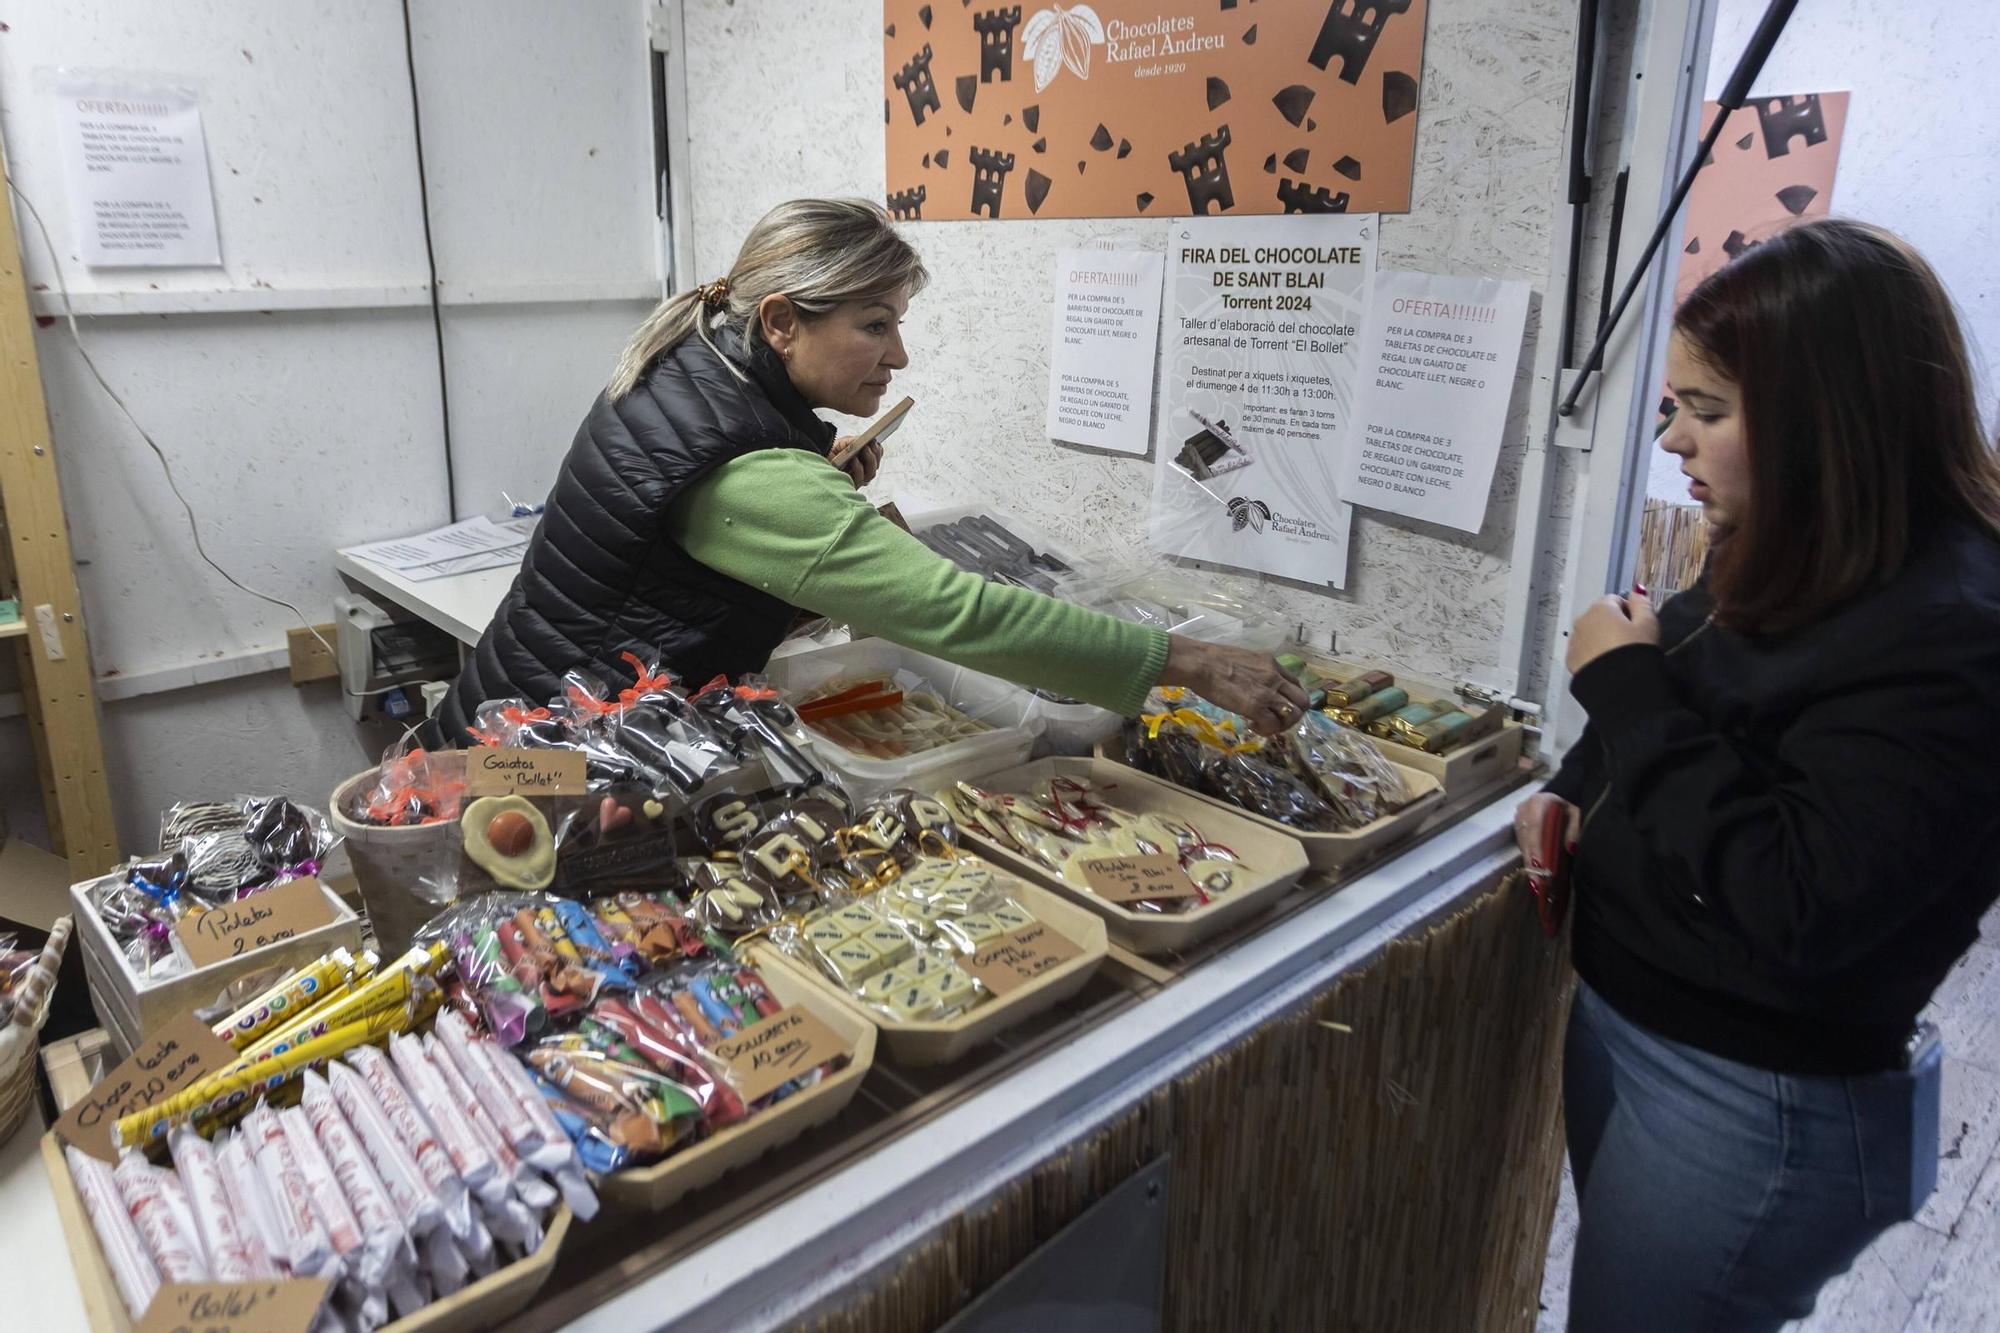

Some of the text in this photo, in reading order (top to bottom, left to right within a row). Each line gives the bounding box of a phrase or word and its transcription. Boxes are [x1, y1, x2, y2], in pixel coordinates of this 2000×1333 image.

[1107, 16, 1194, 42] Chocolates
[1106, 33, 1225, 63] Rafael Andreu
[1135, 63, 1186, 78] desde 1920
[1182, 247, 1361, 264] FIRA DEL CHOCOLATE
[1213, 272, 1324, 288] DE SANT BLAI
[1102, 307, 1134, 316] CHOCOLATE
[1222, 294, 1312, 311] Torrent 2024
[1392, 299, 1496, 323] OFERTA!!!!!!!
[1180, 318, 1207, 329] Taller
[1279, 322, 1295, 333] del
[1299, 322, 1355, 336] chocolate
[1387, 326, 1472, 344] PER LA COMPRA DE 3
[1184, 335, 1230, 347] artesanal
[1234, 336, 1247, 349] de
[1251, 338, 1288, 350] Torrent
[1385, 339, 1497, 361] TABLETAS DE CHOCOLATE DE
[1381, 352, 1467, 372] REGAL UN GAIATO DE
[1192, 366, 1226, 377] Destinat
[1228, 370, 1242, 380] per
[1244, 371, 1250, 379] a
[1252, 371, 1284, 383] xiquets
[1291, 374, 1332, 386] xiquetes,
[1379, 365, 1485, 389] CHOCOLATE LLET, NEGRE O
[1186, 380, 1194, 388] el
[1196, 380, 1237, 393] diumenge
[1240, 383, 1245, 392] 4
[1248, 383, 1258, 393] de
[1262, 385, 1290, 396] 11:30h
[1294, 389, 1299, 397] a
[1243, 414, 1251, 422] de
[1253, 415, 1262, 423] 30
[1290, 419, 1300, 427] En
[1302, 420, 1319, 429] cada
[1321, 422, 1335, 430] torn
[1289, 407, 1308, 416] faran
[1310, 409, 1315, 417] 3
[1317, 410, 1335, 419] torns
[1059, 417, 1075, 425] NEGRO
[1083, 420, 1105, 429] BLANCO
[1265, 426, 1274, 435] de
[1276, 427, 1285, 436] 40
[1368, 424, 1451, 447] POR LA COMPRA DE 3
[1366, 437, 1400, 451] TABLETAS
[1402, 444, 1413, 454] DE
[1360, 463, 1404, 479] CHOCOLATE
[1406, 472, 1424, 483] CON
[1363, 450, 1464, 478] DE REGALO UN GAYATO DE
[1358, 475, 1425, 497] NEGRO O BLANCO
[1272, 512, 1316, 528] Chocolates
[1272, 522, 1297, 535] Rafael
[1298, 524, 1330, 541] Andreu
[484, 754, 534, 769] Gaiatos
[232, 937, 248, 957] 2
